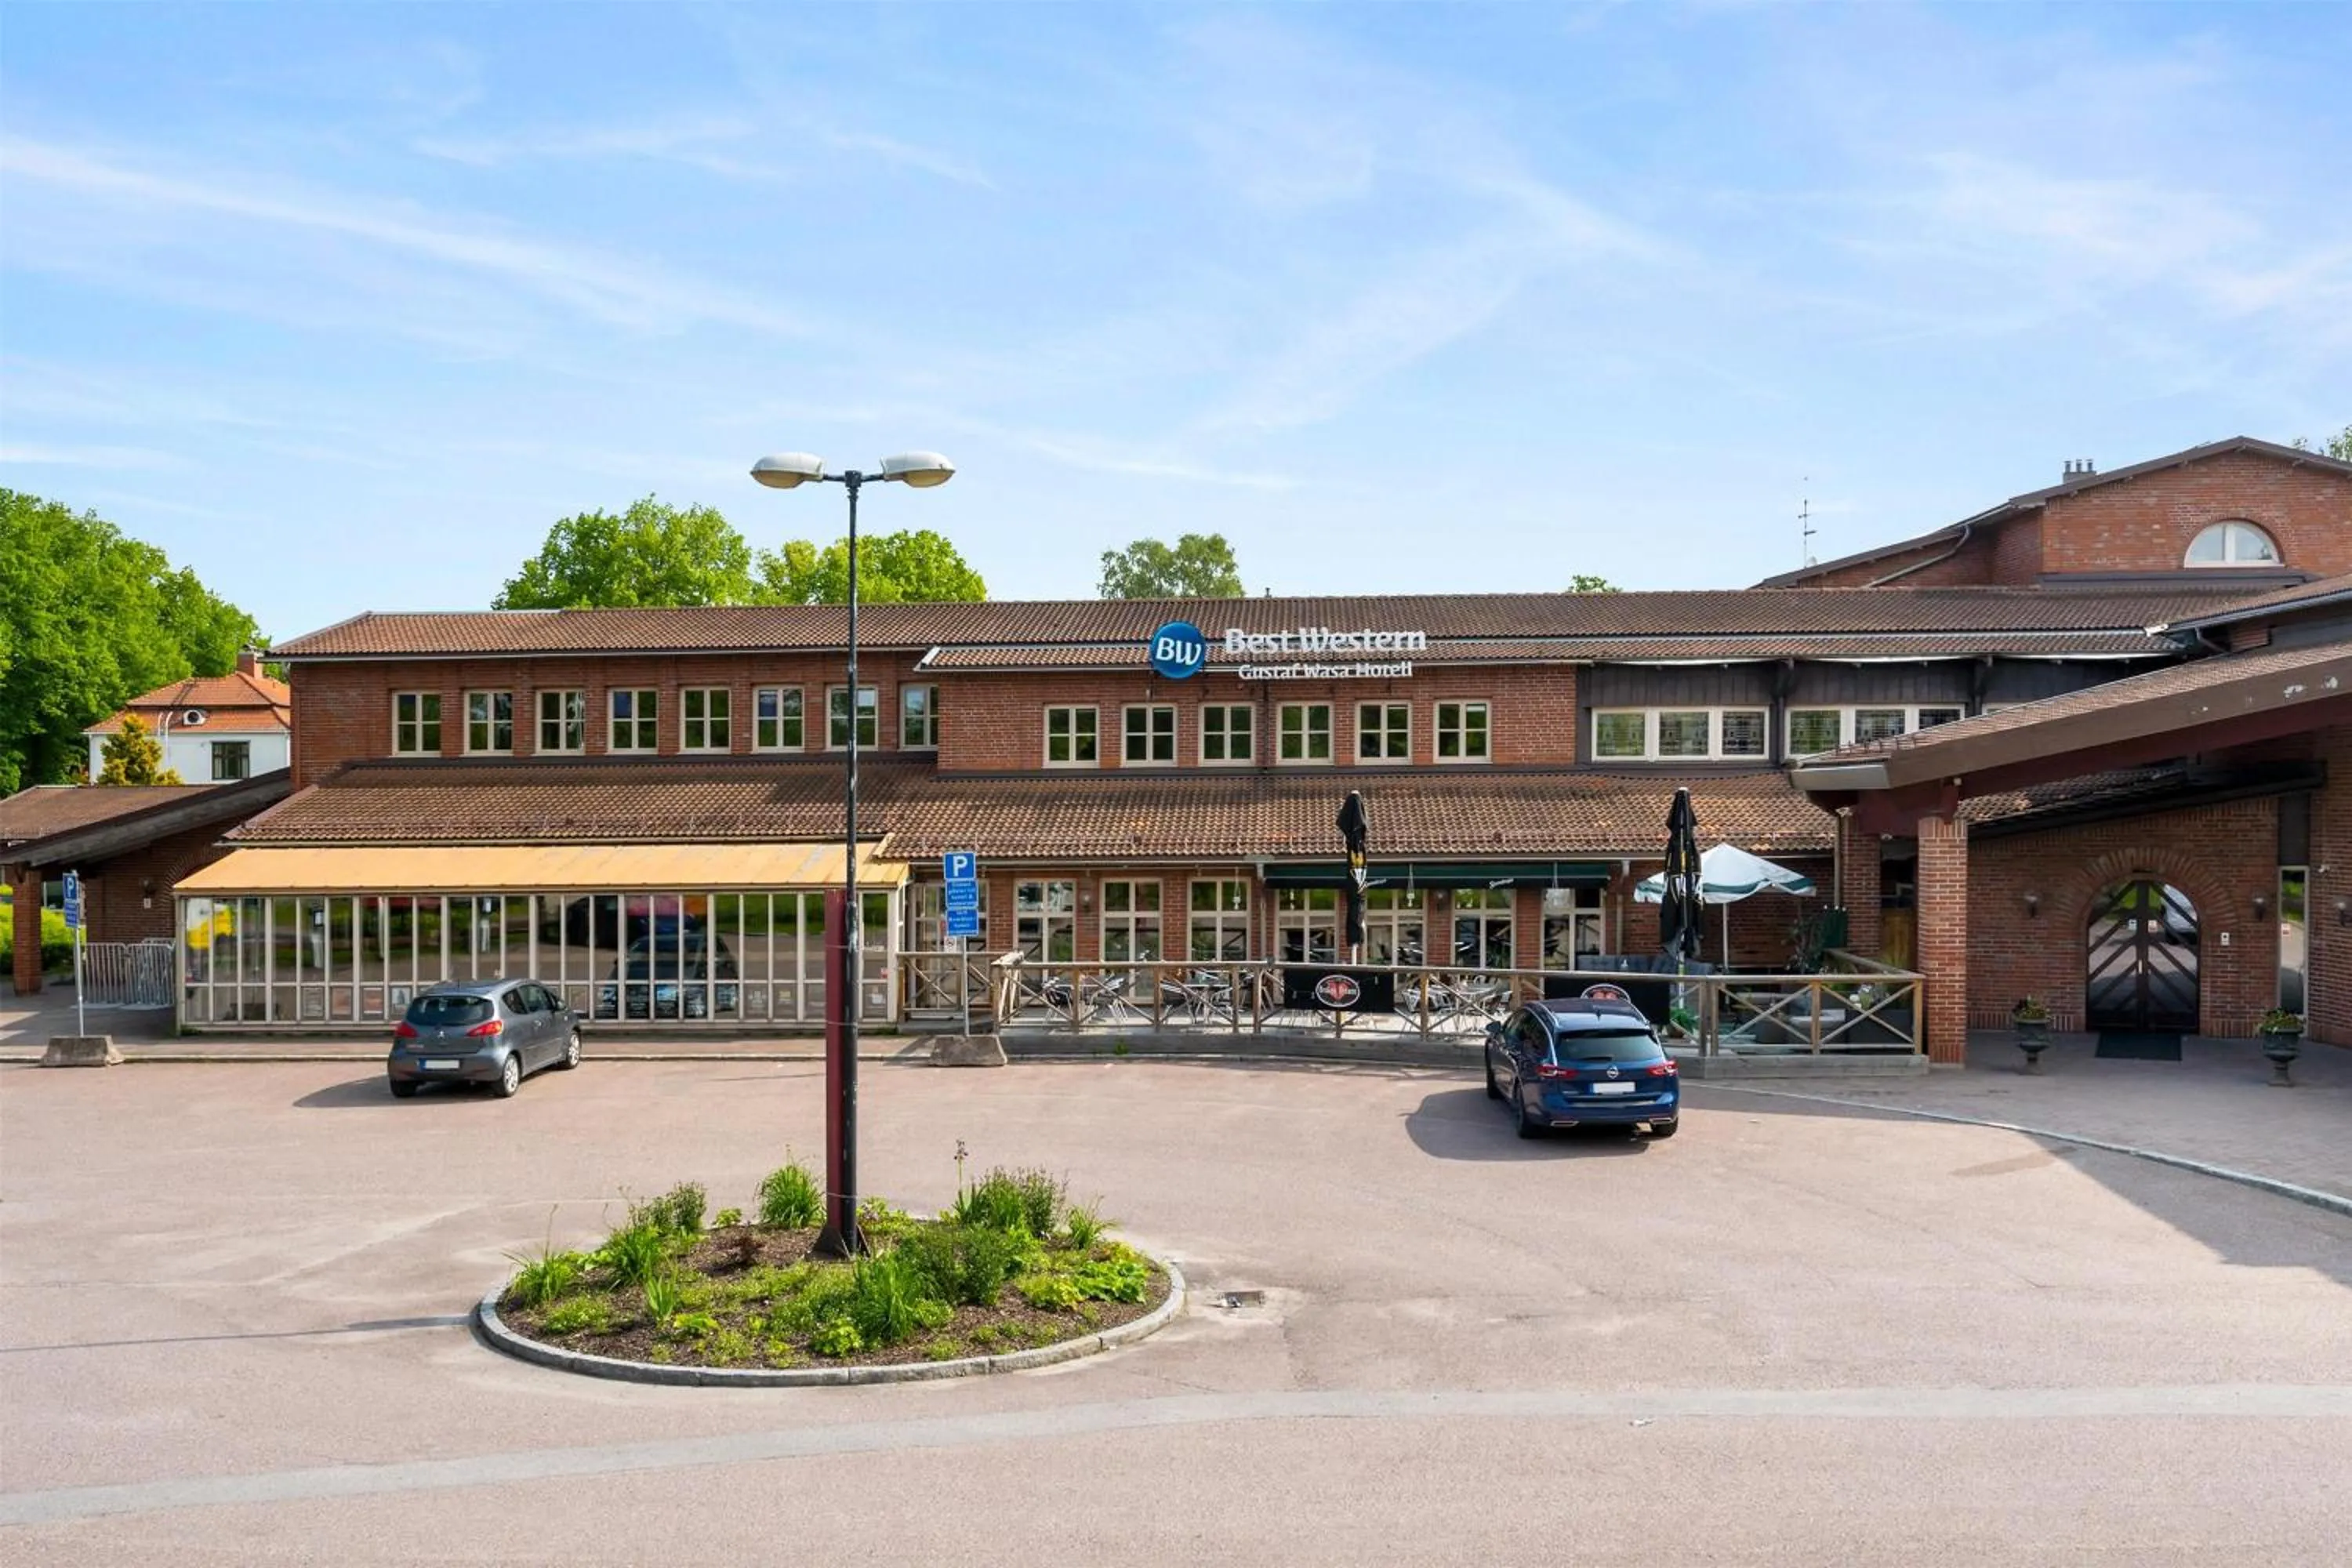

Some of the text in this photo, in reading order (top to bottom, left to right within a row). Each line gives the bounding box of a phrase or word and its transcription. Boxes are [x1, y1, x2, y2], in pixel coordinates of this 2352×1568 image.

[1156, 637, 1202, 666] BW
[1225, 626, 1427, 655] Best Western
[1238, 663, 1302, 680] Gustaf
[1356, 661, 1413, 678] Hotell
[953, 855, 968, 877] P
[67, 877, 74, 898] P
